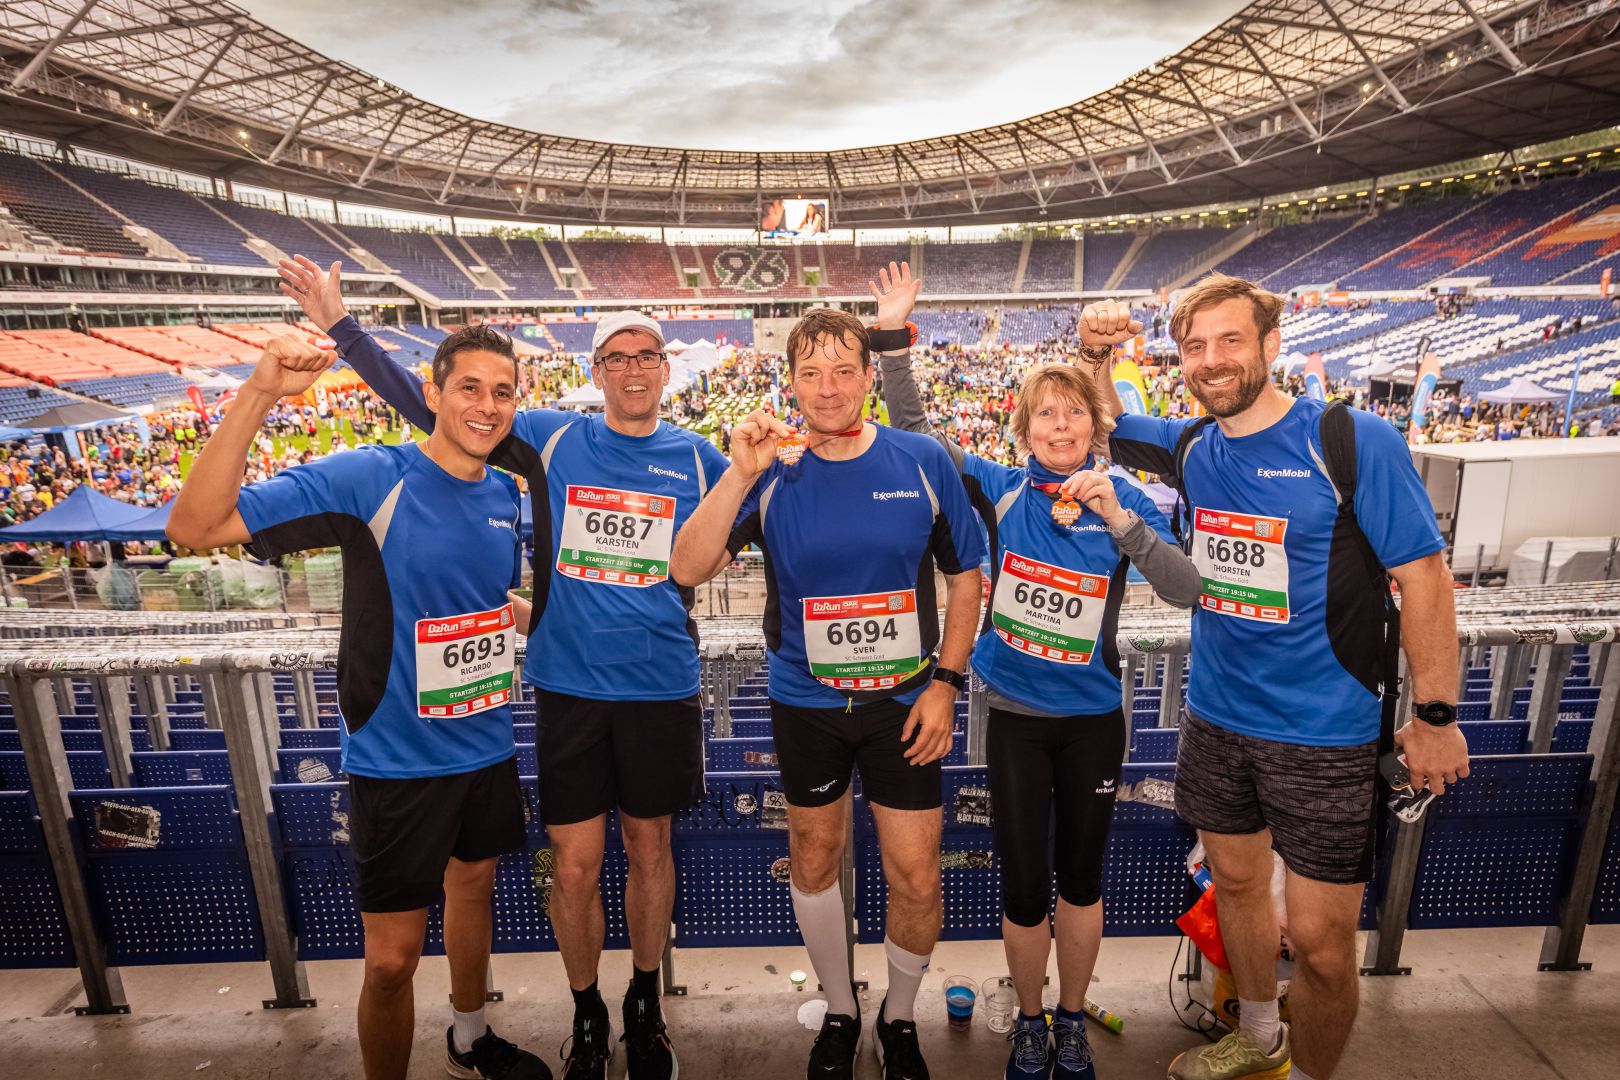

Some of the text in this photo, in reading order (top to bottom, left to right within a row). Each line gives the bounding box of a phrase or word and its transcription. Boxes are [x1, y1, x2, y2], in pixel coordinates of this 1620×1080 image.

[648, 464, 688, 480] ExxonMobil
[1258, 468, 1310, 478] ExxonMobil
[576, 490, 604, 500] B2Run
[873, 490, 919, 500] ExxonMobil
[1051, 506, 1082, 515] B2Run
[586, 512, 654, 540] 6687
[595, 536, 639, 549] KARSTEN
[1207, 536, 1265, 568] 6688
[585, 556, 615, 564] STARTZEIT
[1010, 558, 1035, 572] B2Run
[1214, 564, 1250, 576] THORSTEN
[1208, 584, 1229, 594] STARTZEIT
[813, 602, 840, 611] B2Run
[1015, 582, 1082, 619] 6690
[1026, 609, 1061, 625] MARTINA
[428, 623, 458, 634] B2Run
[827, 618, 898, 645] 6694
[1012, 624, 1040, 638] STARTZEIT
[1041, 634, 1057, 642] 19:15
[443, 634, 505, 668] 6693
[460, 662, 492, 676] RICARDO
[450, 687, 478, 698] STARTZEIT
[770, 795, 783, 807] 96
